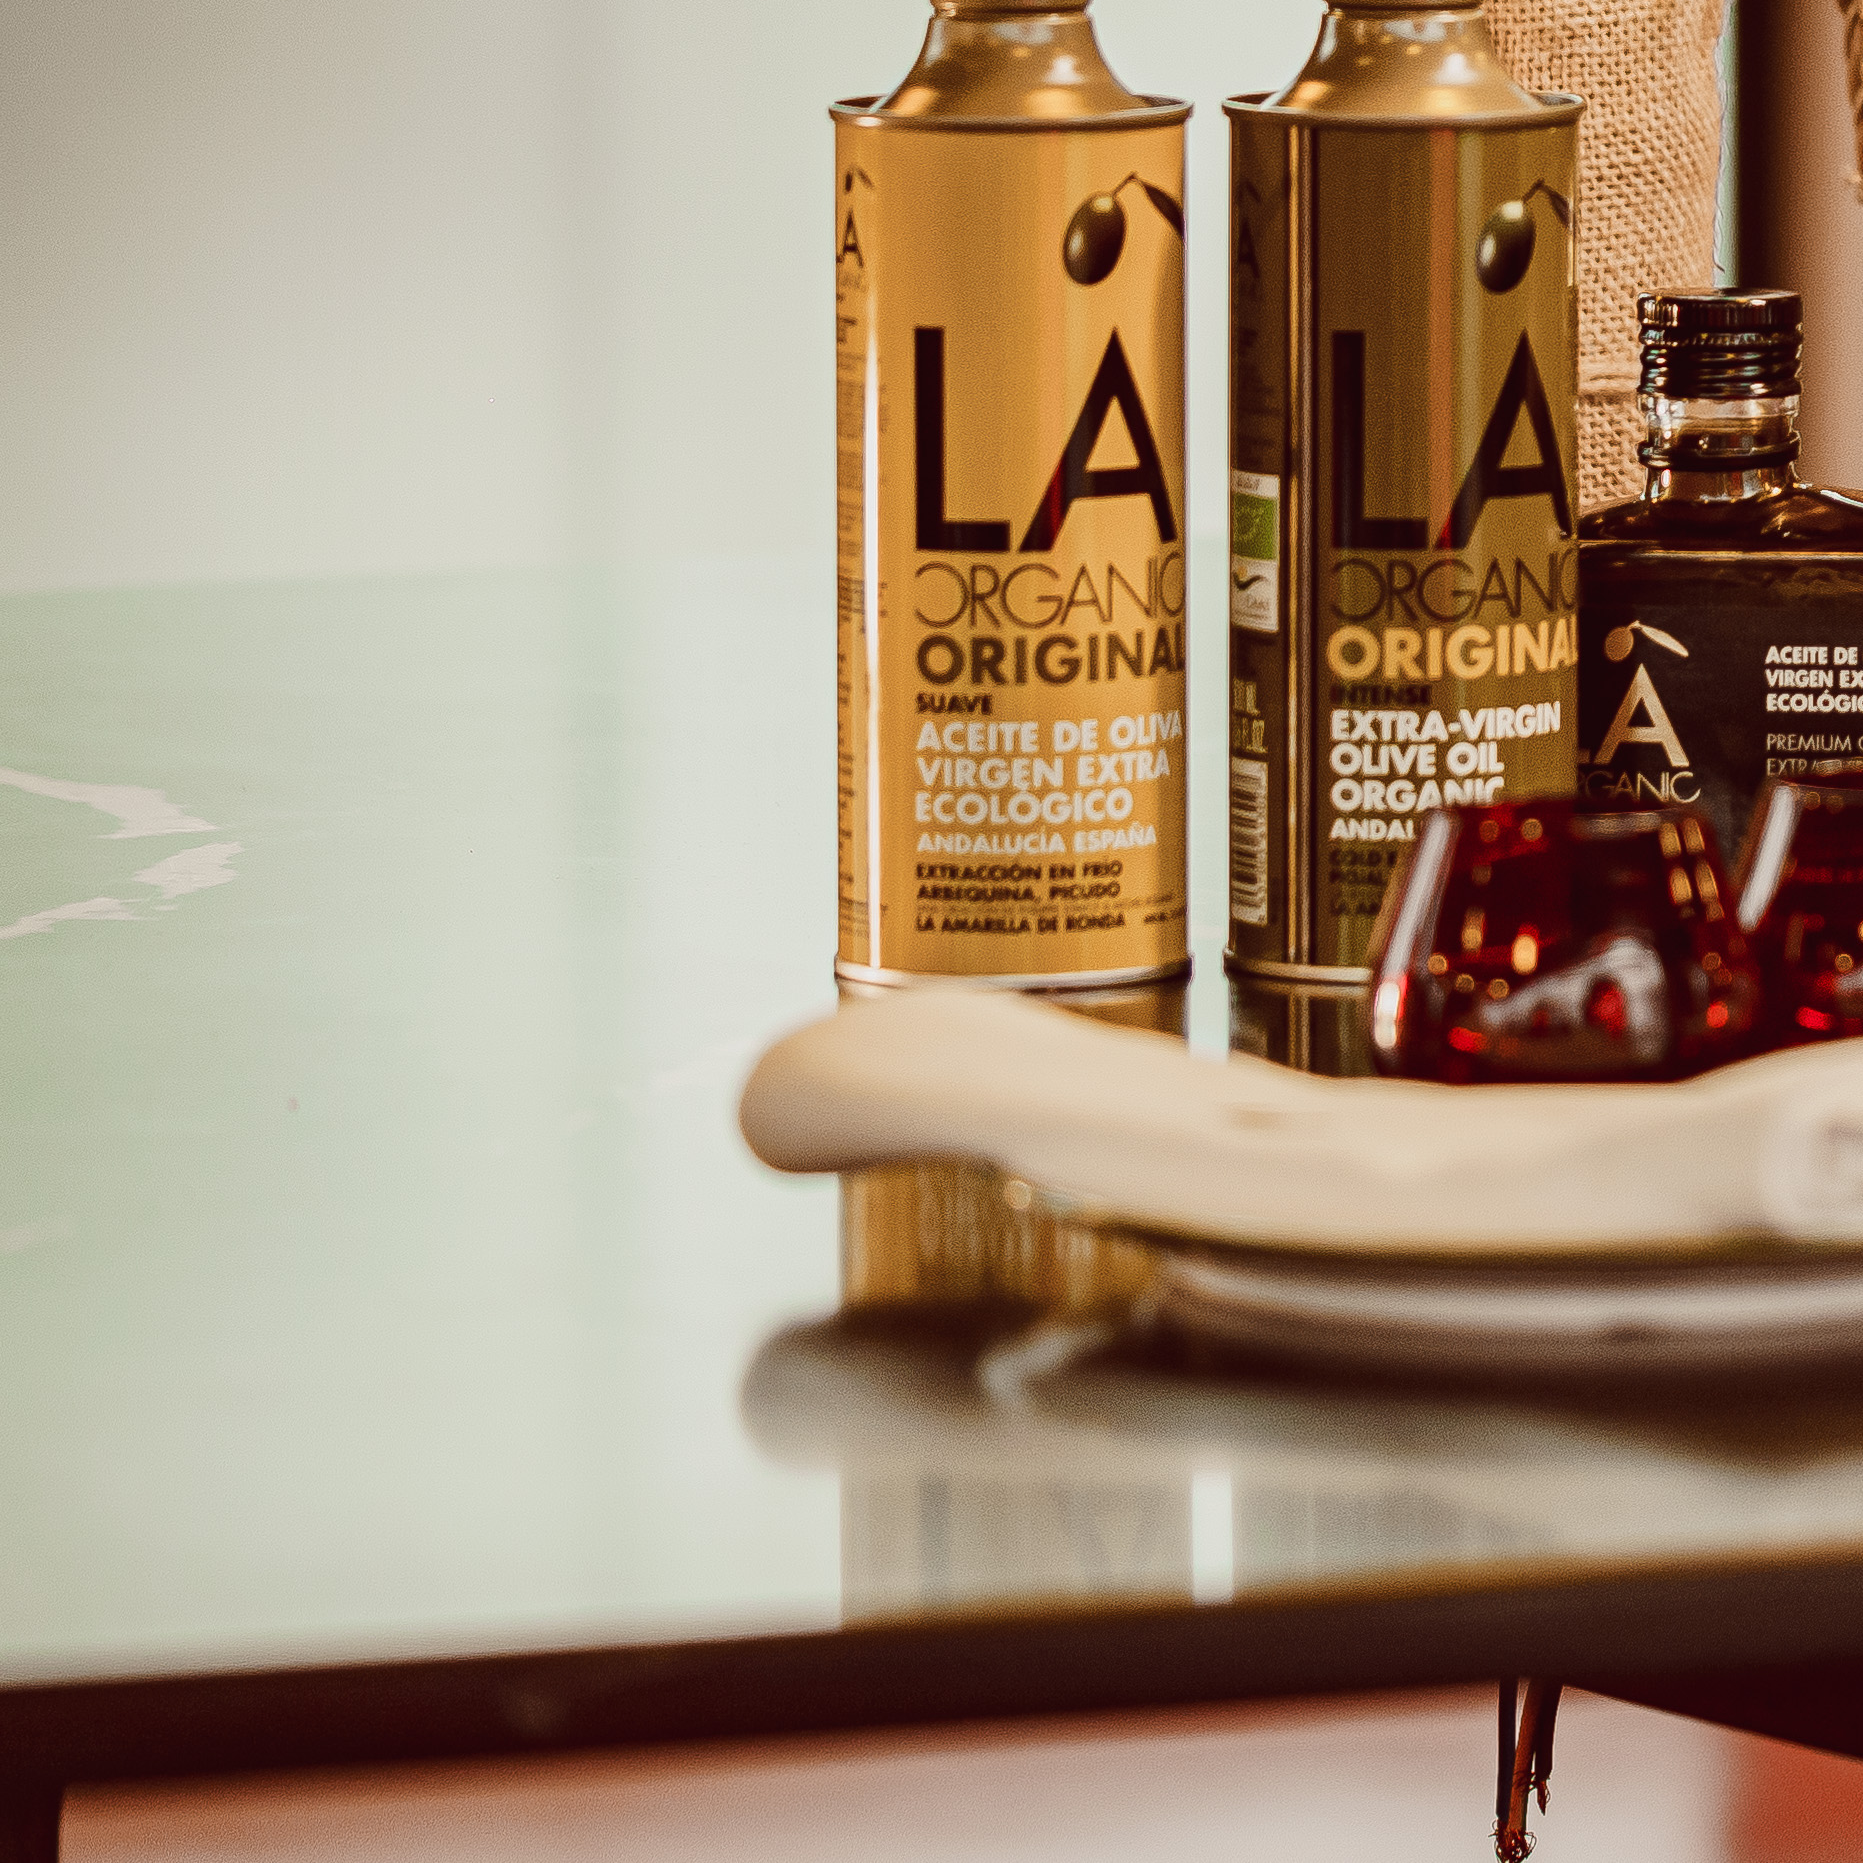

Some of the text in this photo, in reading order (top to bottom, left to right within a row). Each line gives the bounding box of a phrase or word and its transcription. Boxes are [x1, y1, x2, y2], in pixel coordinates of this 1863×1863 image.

[914, 326, 1178, 553] LA
[1331, 327, 1573, 551] LA
[914, 550, 1185, 629] ORGANIC
[915, 625, 1185, 686] ORIGINAL
[1765, 645, 1828, 665] ACEITE
[1833, 646, 1858, 666] DE
[1329, 685, 1431, 706] INTENSE
[1765, 668, 1834, 688] VIRGEN
[915, 692, 994, 716] SUAVE
[1330, 700, 1561, 742] EXTRA-VIRGIN
[916, 710, 1183, 753] ACEITE DE OLIVA
[1766, 733, 1852, 752] PREMIUM
[916, 748, 1170, 789] VIRGEN EXTRA
[1330, 740, 1505, 777] OLIVE OIL
[914, 786, 1134, 825] ECOLÓGICO
[916, 822, 1157, 855] ANDALUCÍA ESPAÑA
[915, 862, 1041, 881] EXTRACCIÓN
[1049, 863, 1075, 880] EN
[1049, 881, 1121, 900] PICUDO
[916, 915, 936, 933] LA
[941, 915, 1031, 935] AMARILLA
[1037, 916, 1057, 934] DE
[1065, 912, 1126, 932] RONDA
